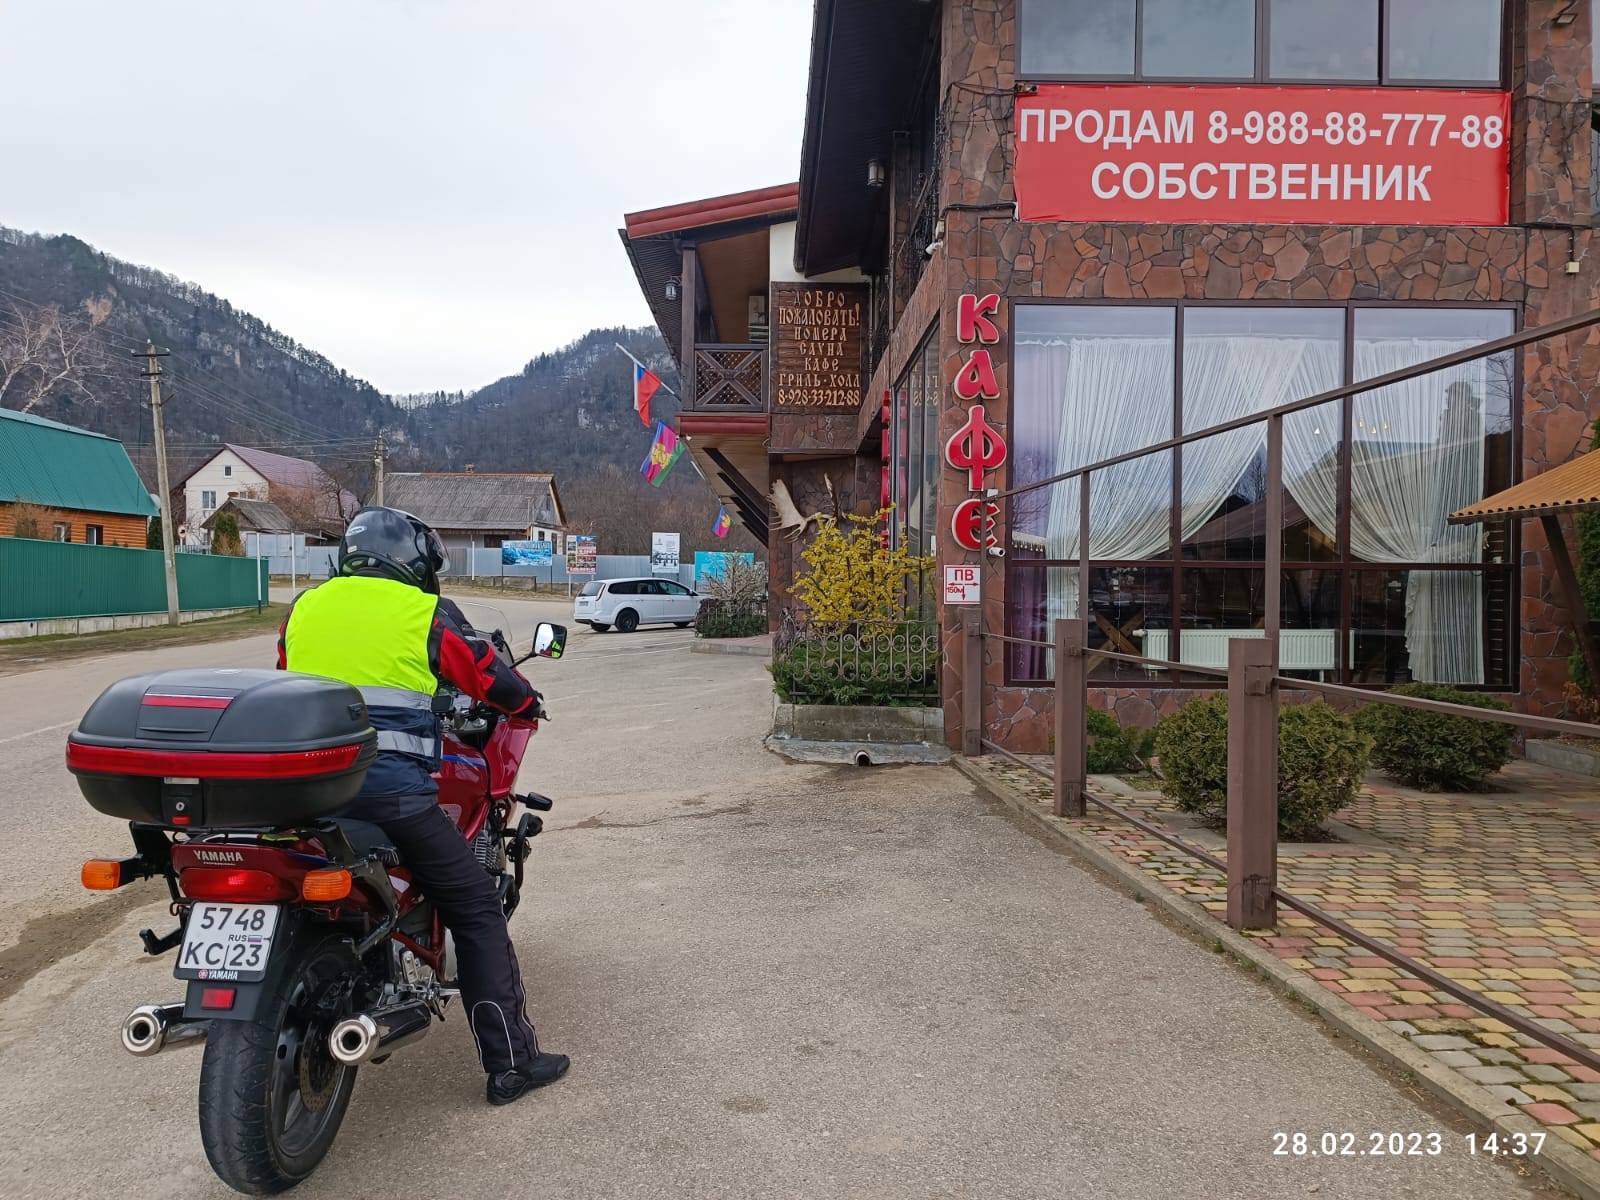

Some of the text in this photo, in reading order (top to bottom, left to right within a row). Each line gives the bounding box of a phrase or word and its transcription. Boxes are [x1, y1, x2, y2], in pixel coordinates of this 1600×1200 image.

[1020, 108, 1504, 150] ПРОДАМ 8-988-88-777-88
[1092, 161, 1432, 201] СОБСТВЕННИК
[793, 290, 845, 307] ДОБРО
[779, 303, 860, 326] ПОЖАЛОВАТЬ!
[794, 326, 847, 341] НОМЕРА
[799, 342, 844, 356] САУНА
[804, 357, 839, 371] КАФЕ
[954, 569, 974, 581] ПВ
[193, 849, 244, 861] YAMAHA
[201, 907, 266, 931] 5748
[228, 934, 247, 942] RUS
[229, 944, 263, 966] 23
[208, 970, 238, 980] YAMAHA
